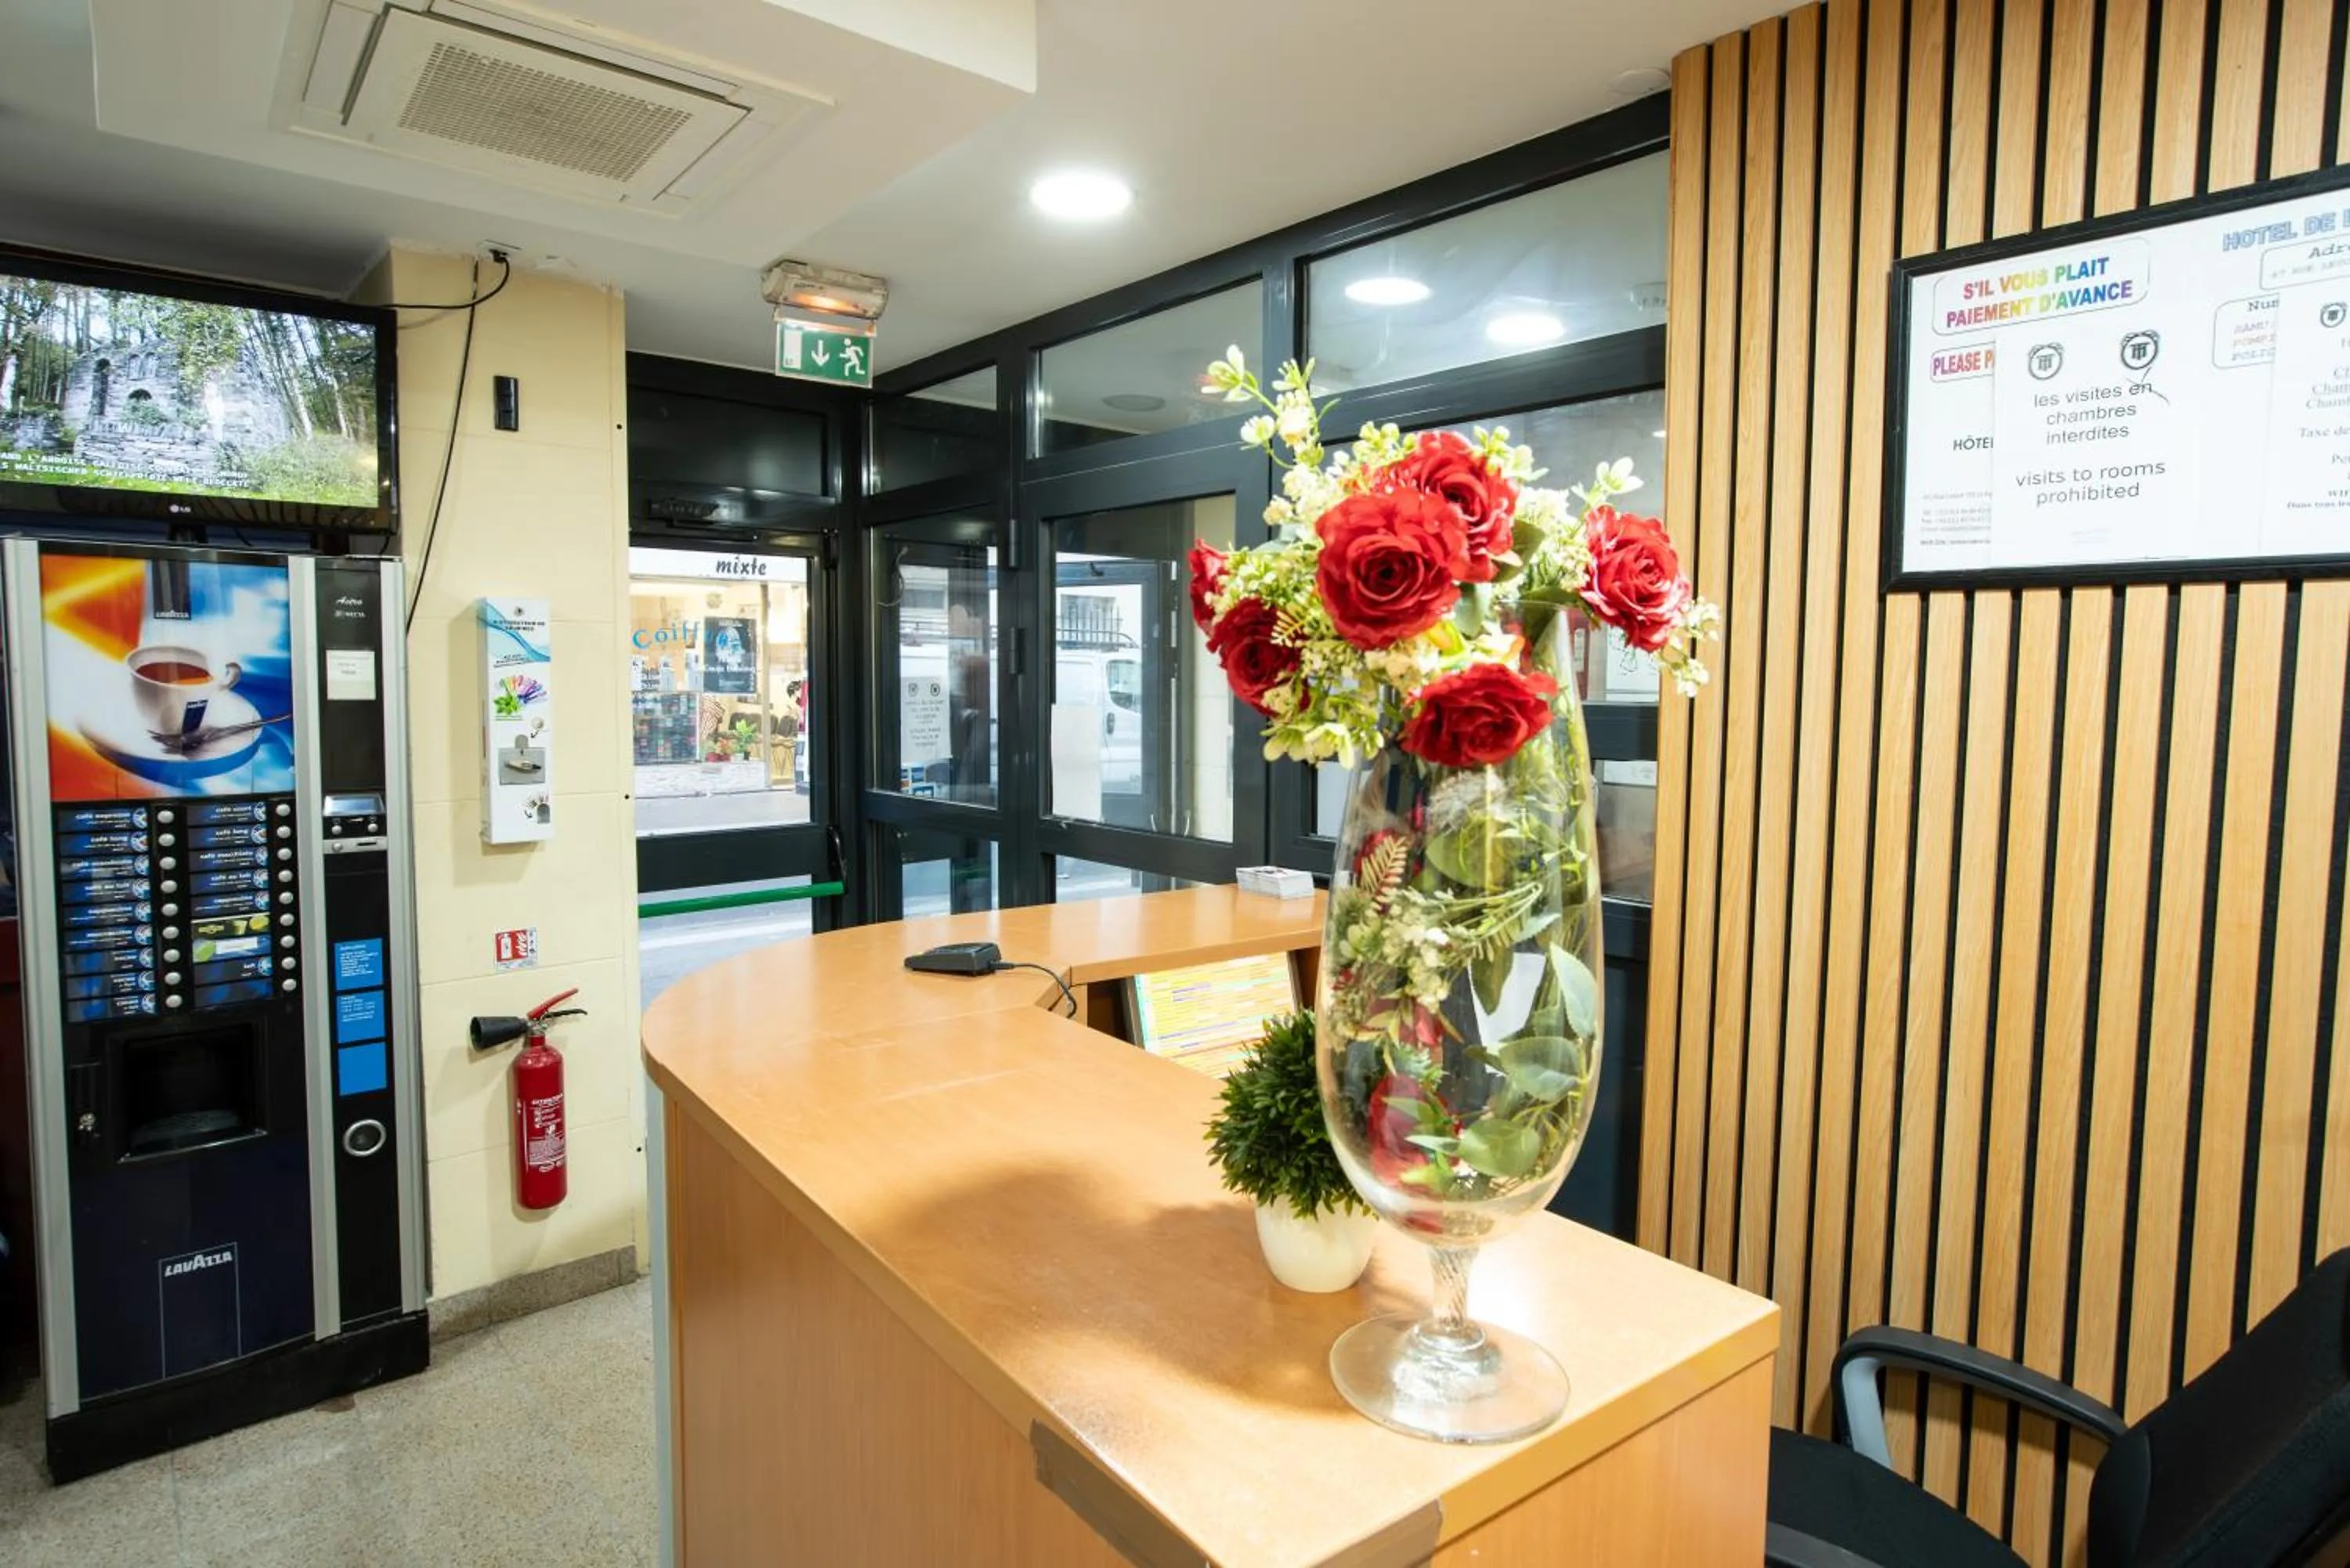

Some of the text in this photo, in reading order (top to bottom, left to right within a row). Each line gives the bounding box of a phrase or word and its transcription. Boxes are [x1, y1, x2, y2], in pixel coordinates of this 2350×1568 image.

[2222, 221, 2298, 251] HOTEL
[2304, 212, 2337, 236] DE
[1963, 257, 2110, 300] S'IL VOUS PLAIT
[1946, 280, 2133, 328] PAIEMENT D'AVANCE
[1932, 352, 1981, 376] PLEASE
[2034, 382, 2153, 408] les visites en
[2046, 404, 2138, 426] chambres
[2046, 425, 2130, 446] interdites
[2016, 462, 2167, 486] visits to rooms
[2037, 482, 2140, 508] prohibited
[715, 555, 767, 576] mixte
[164, 1251, 233, 1277] LAVAZZA
